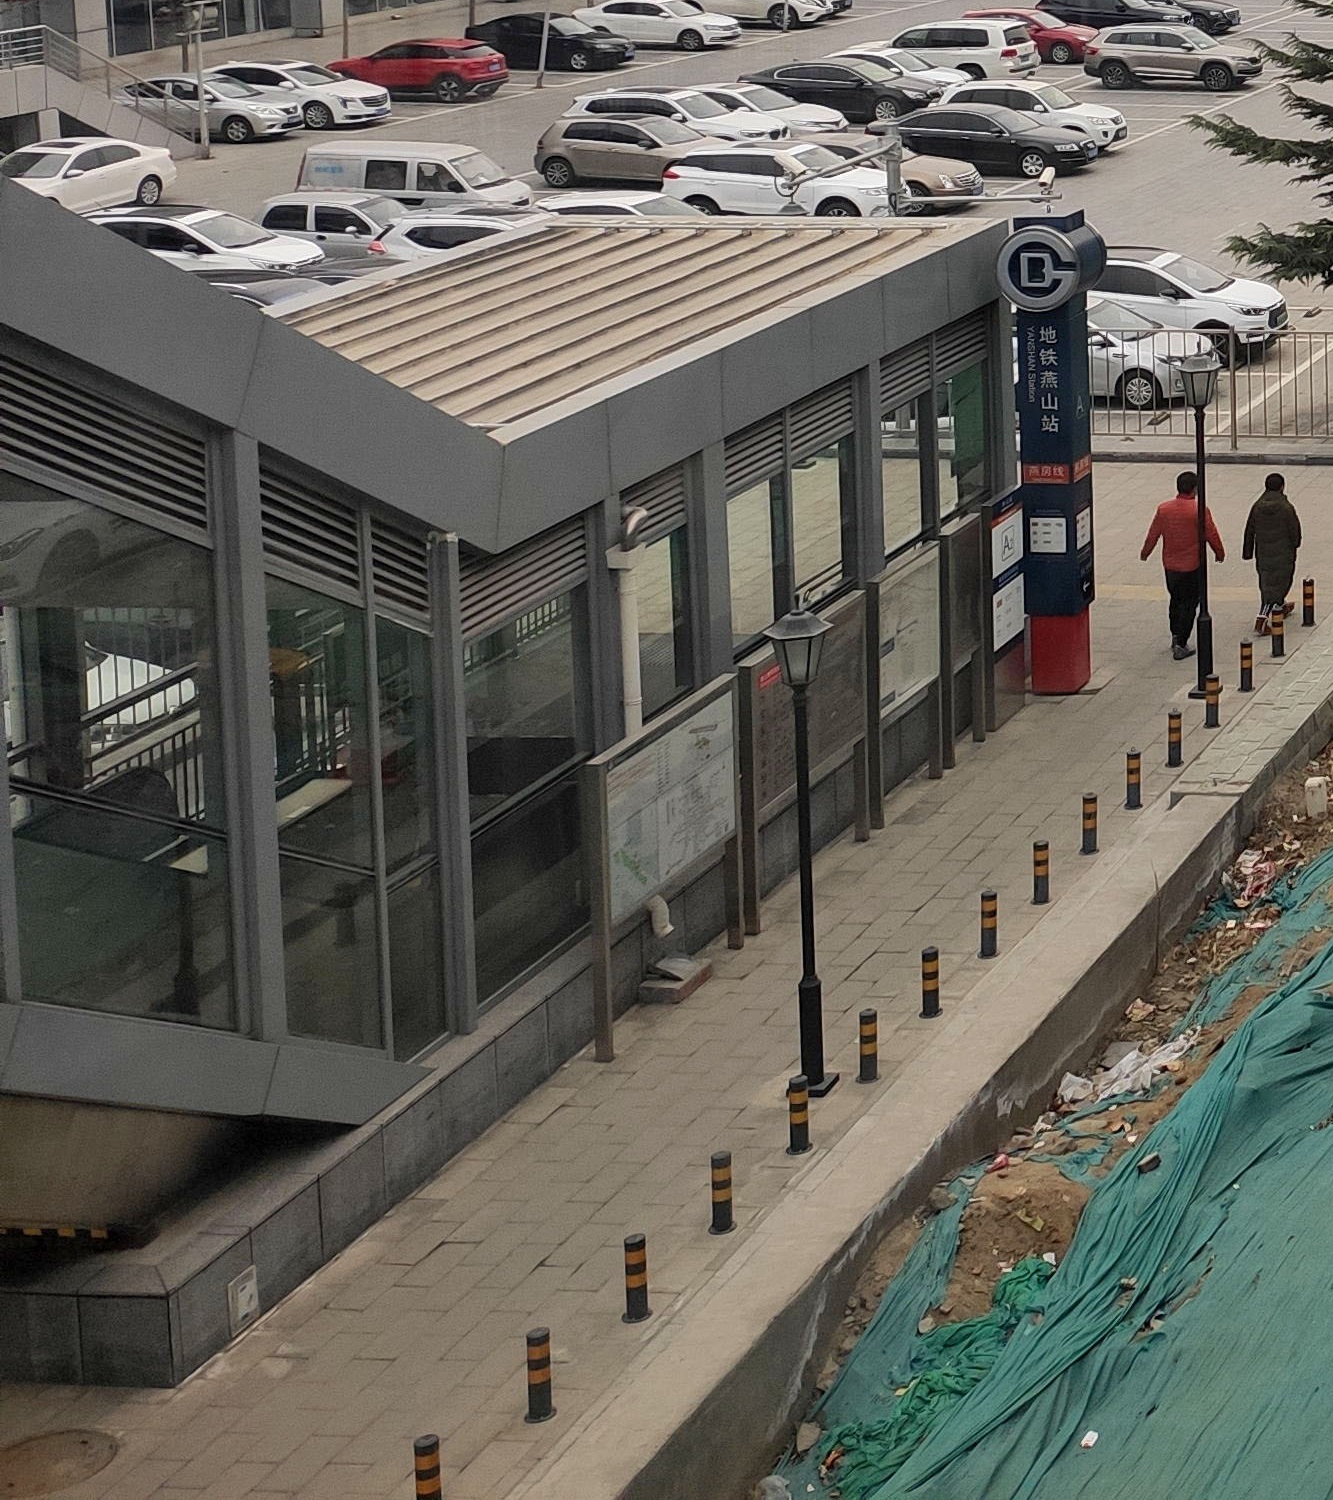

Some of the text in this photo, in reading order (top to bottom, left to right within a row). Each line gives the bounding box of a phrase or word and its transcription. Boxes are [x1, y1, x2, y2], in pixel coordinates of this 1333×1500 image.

[1039, 325, 1060, 433] 地铁燕山站
